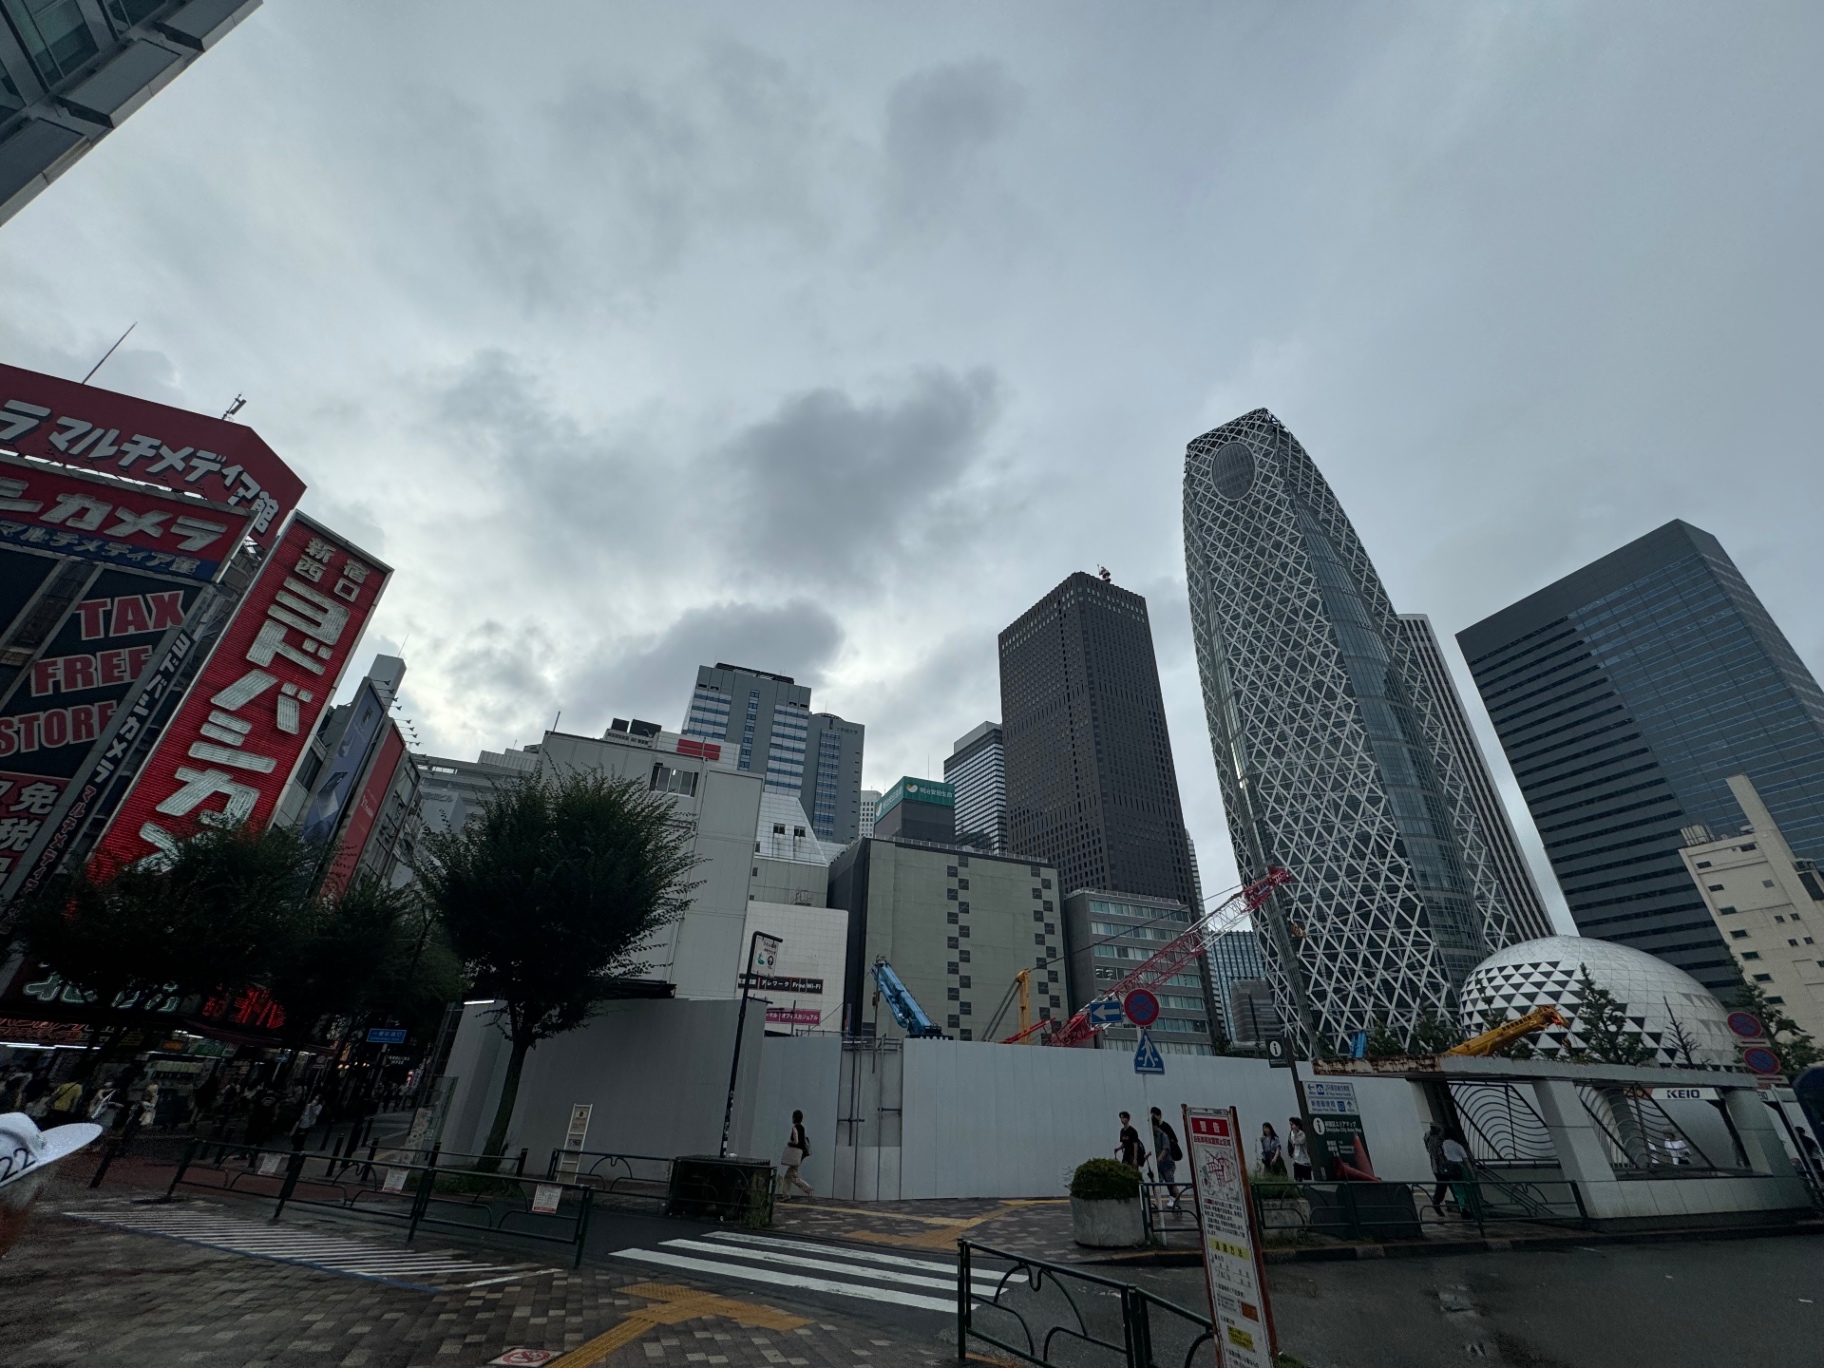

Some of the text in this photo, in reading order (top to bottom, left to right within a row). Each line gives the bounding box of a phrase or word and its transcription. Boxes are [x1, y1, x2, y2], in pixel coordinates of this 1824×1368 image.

[73, 589, 185, 641] TAX
[30, 645, 153, 697] FREE
[93, 632, 191, 784] ヨドバシカメラ
[1667, 1089, 1700, 1098] KEIO
[1199, 1120, 1220, 1134] 警告
